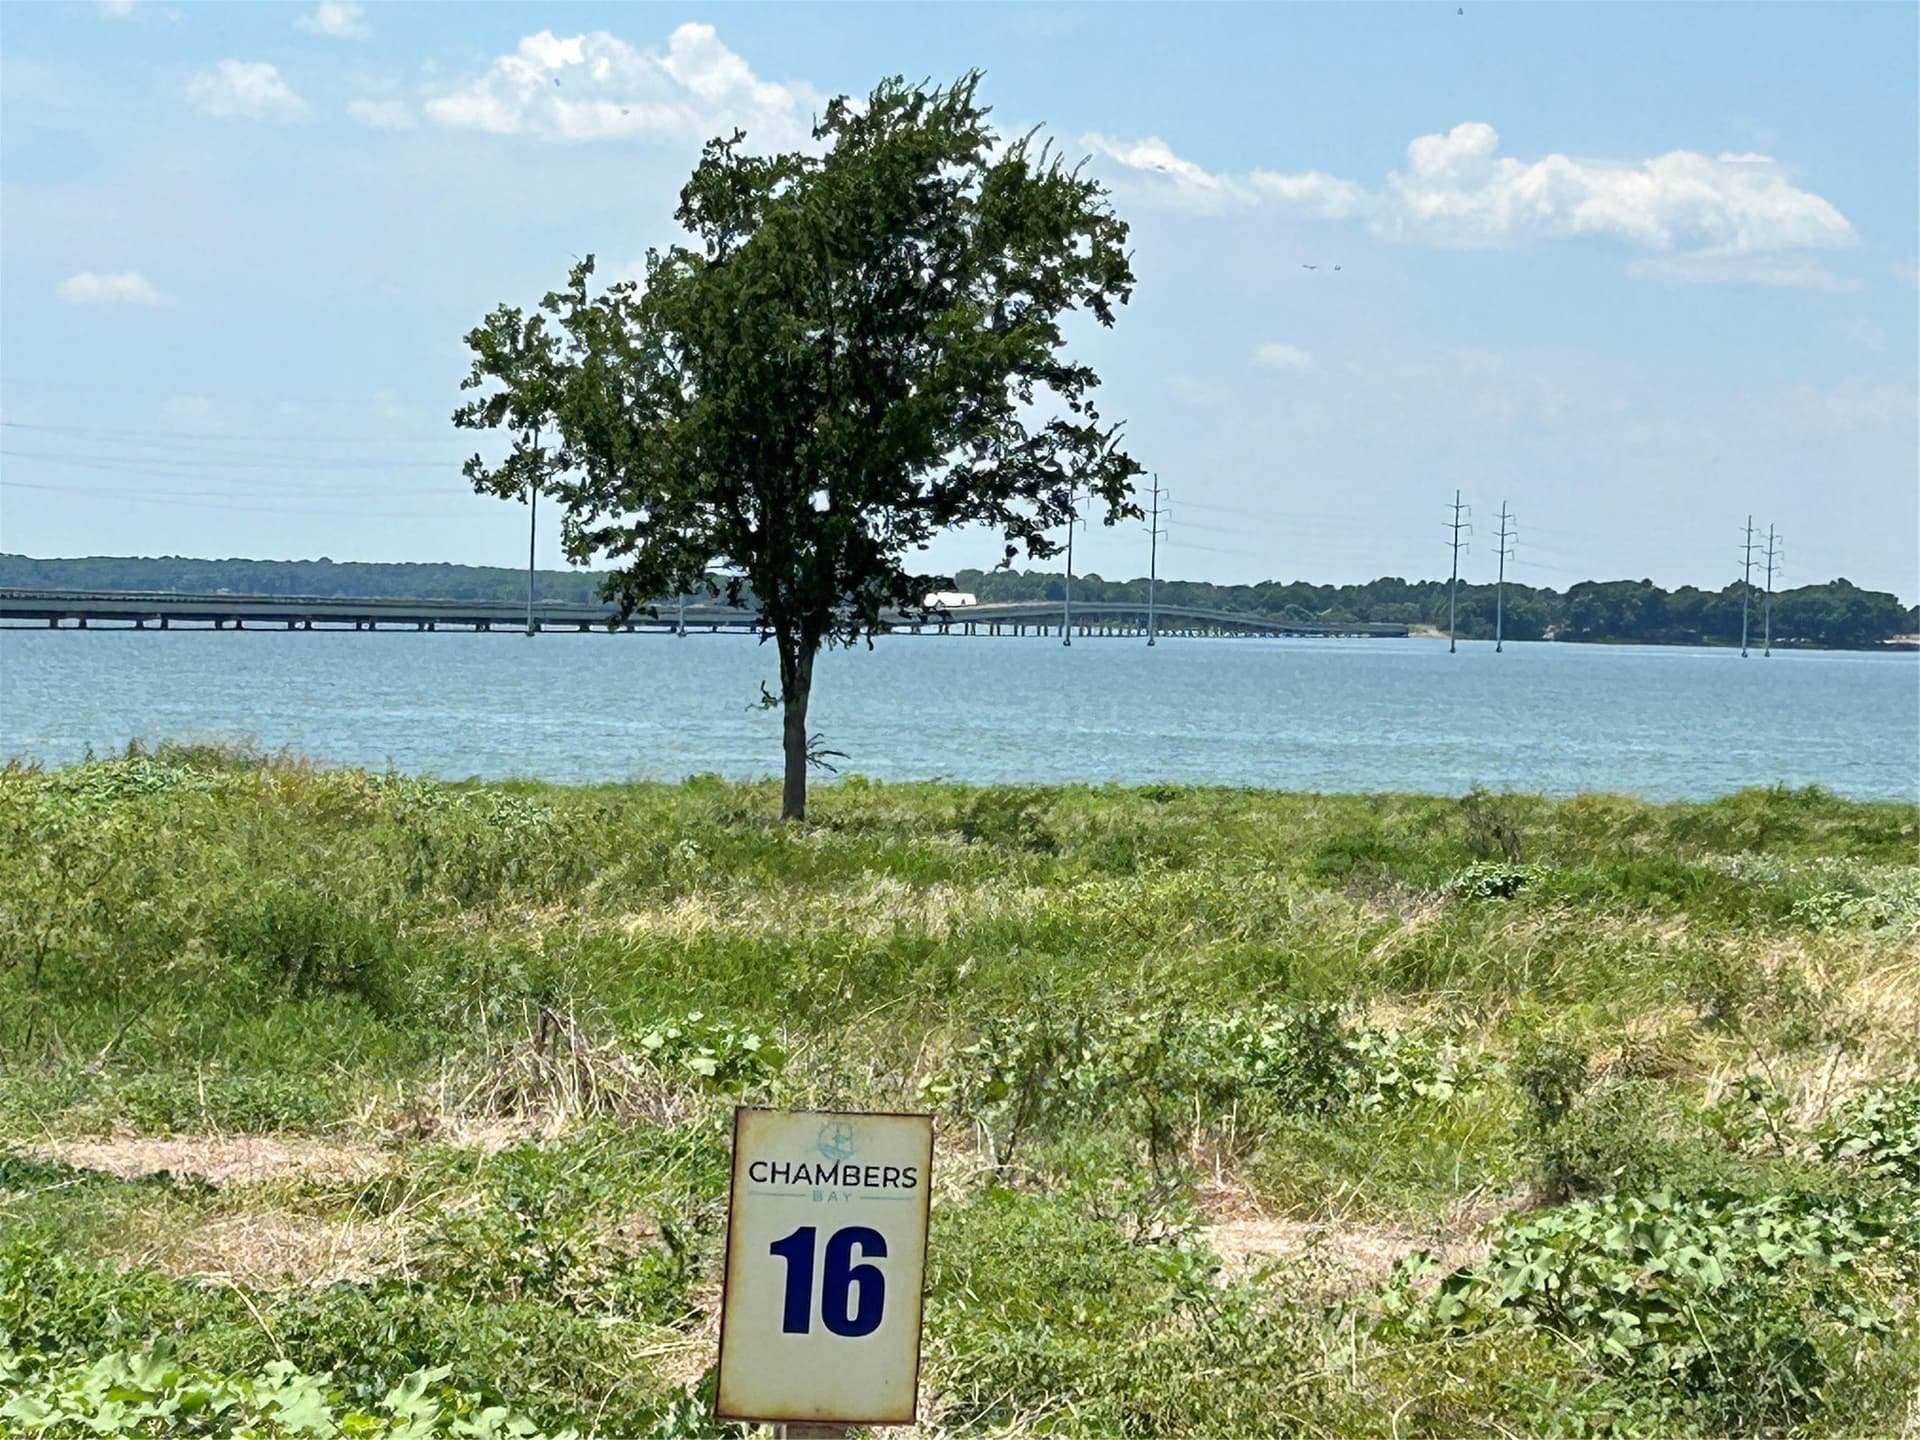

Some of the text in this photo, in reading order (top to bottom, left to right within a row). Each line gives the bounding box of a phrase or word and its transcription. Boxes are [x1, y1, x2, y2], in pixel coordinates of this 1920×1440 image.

[749, 1160, 917, 1189] CHAMBERS
[812, 1190, 852, 1202] BAY
[770, 1226, 887, 1337] 16
